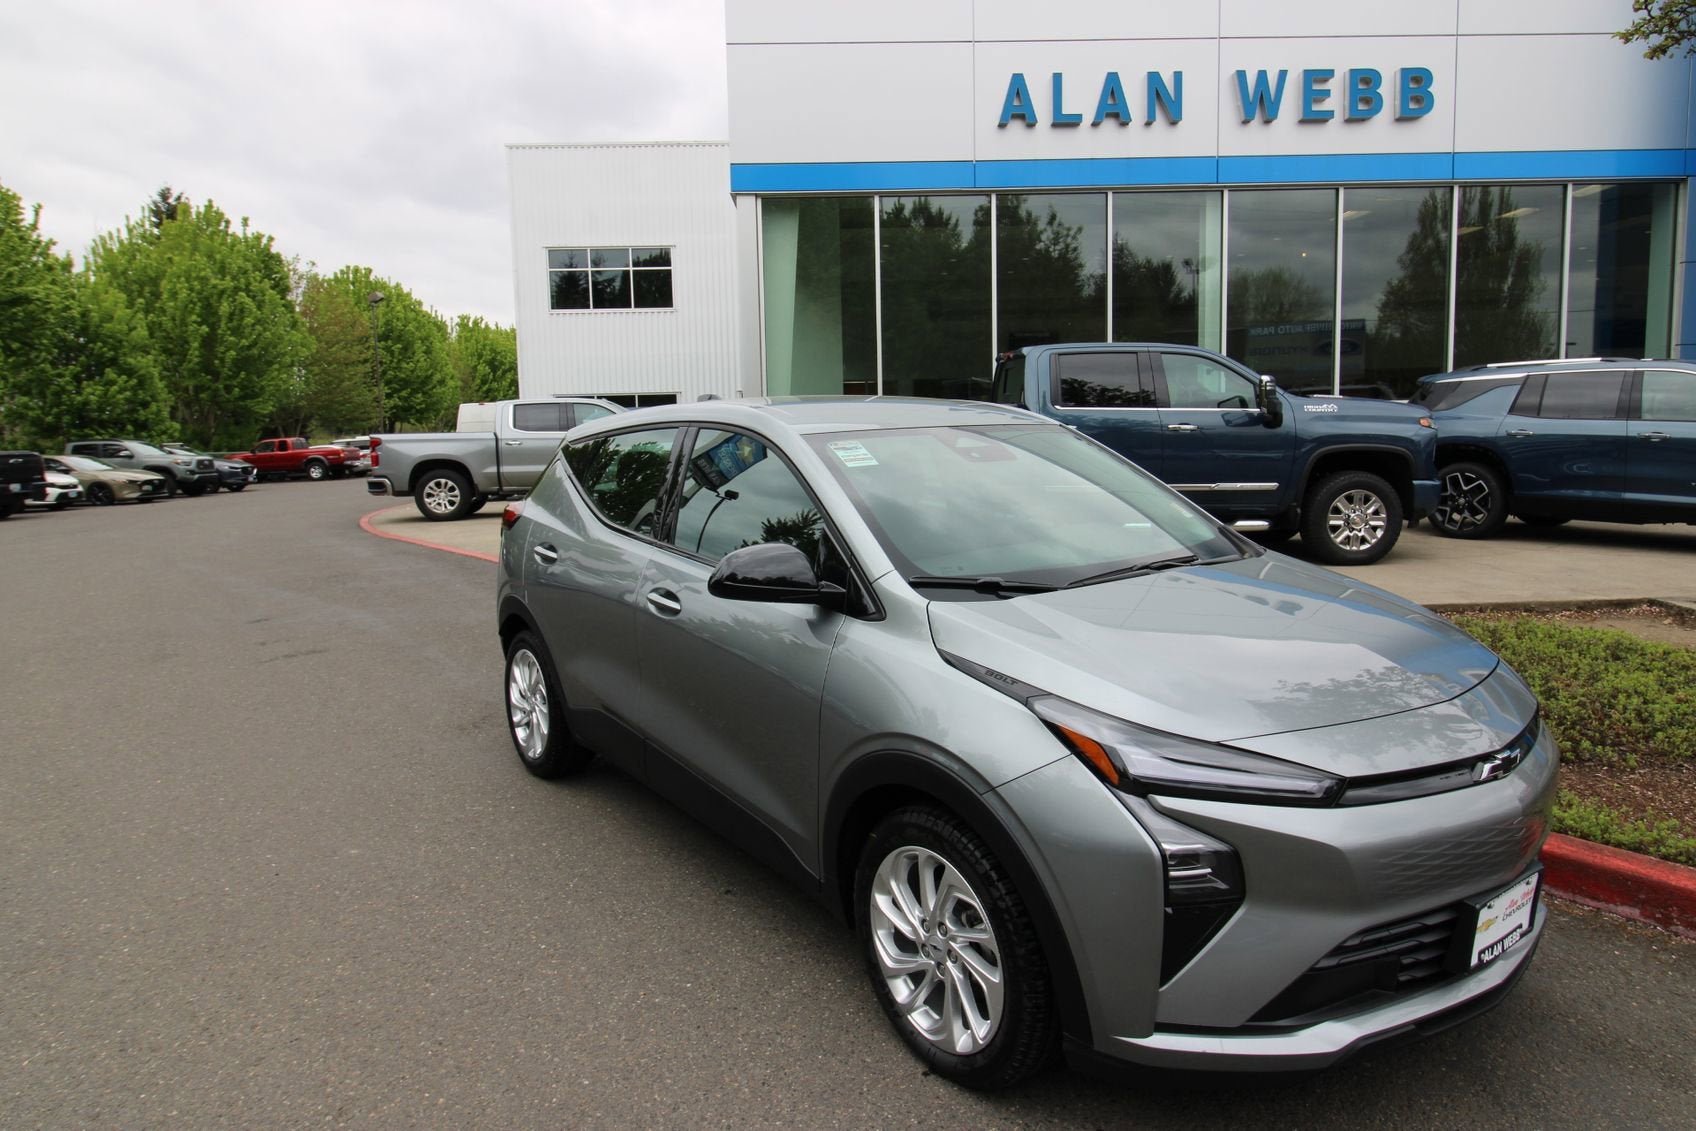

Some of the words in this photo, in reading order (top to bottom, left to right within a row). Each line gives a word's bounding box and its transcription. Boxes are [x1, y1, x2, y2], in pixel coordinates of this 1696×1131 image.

[998, 70, 1183, 127] ALAN
[1232, 67, 1435, 124] WEBB
[985, 669, 1018, 685] BOLT
[1483, 941, 1503, 963] ALAN
